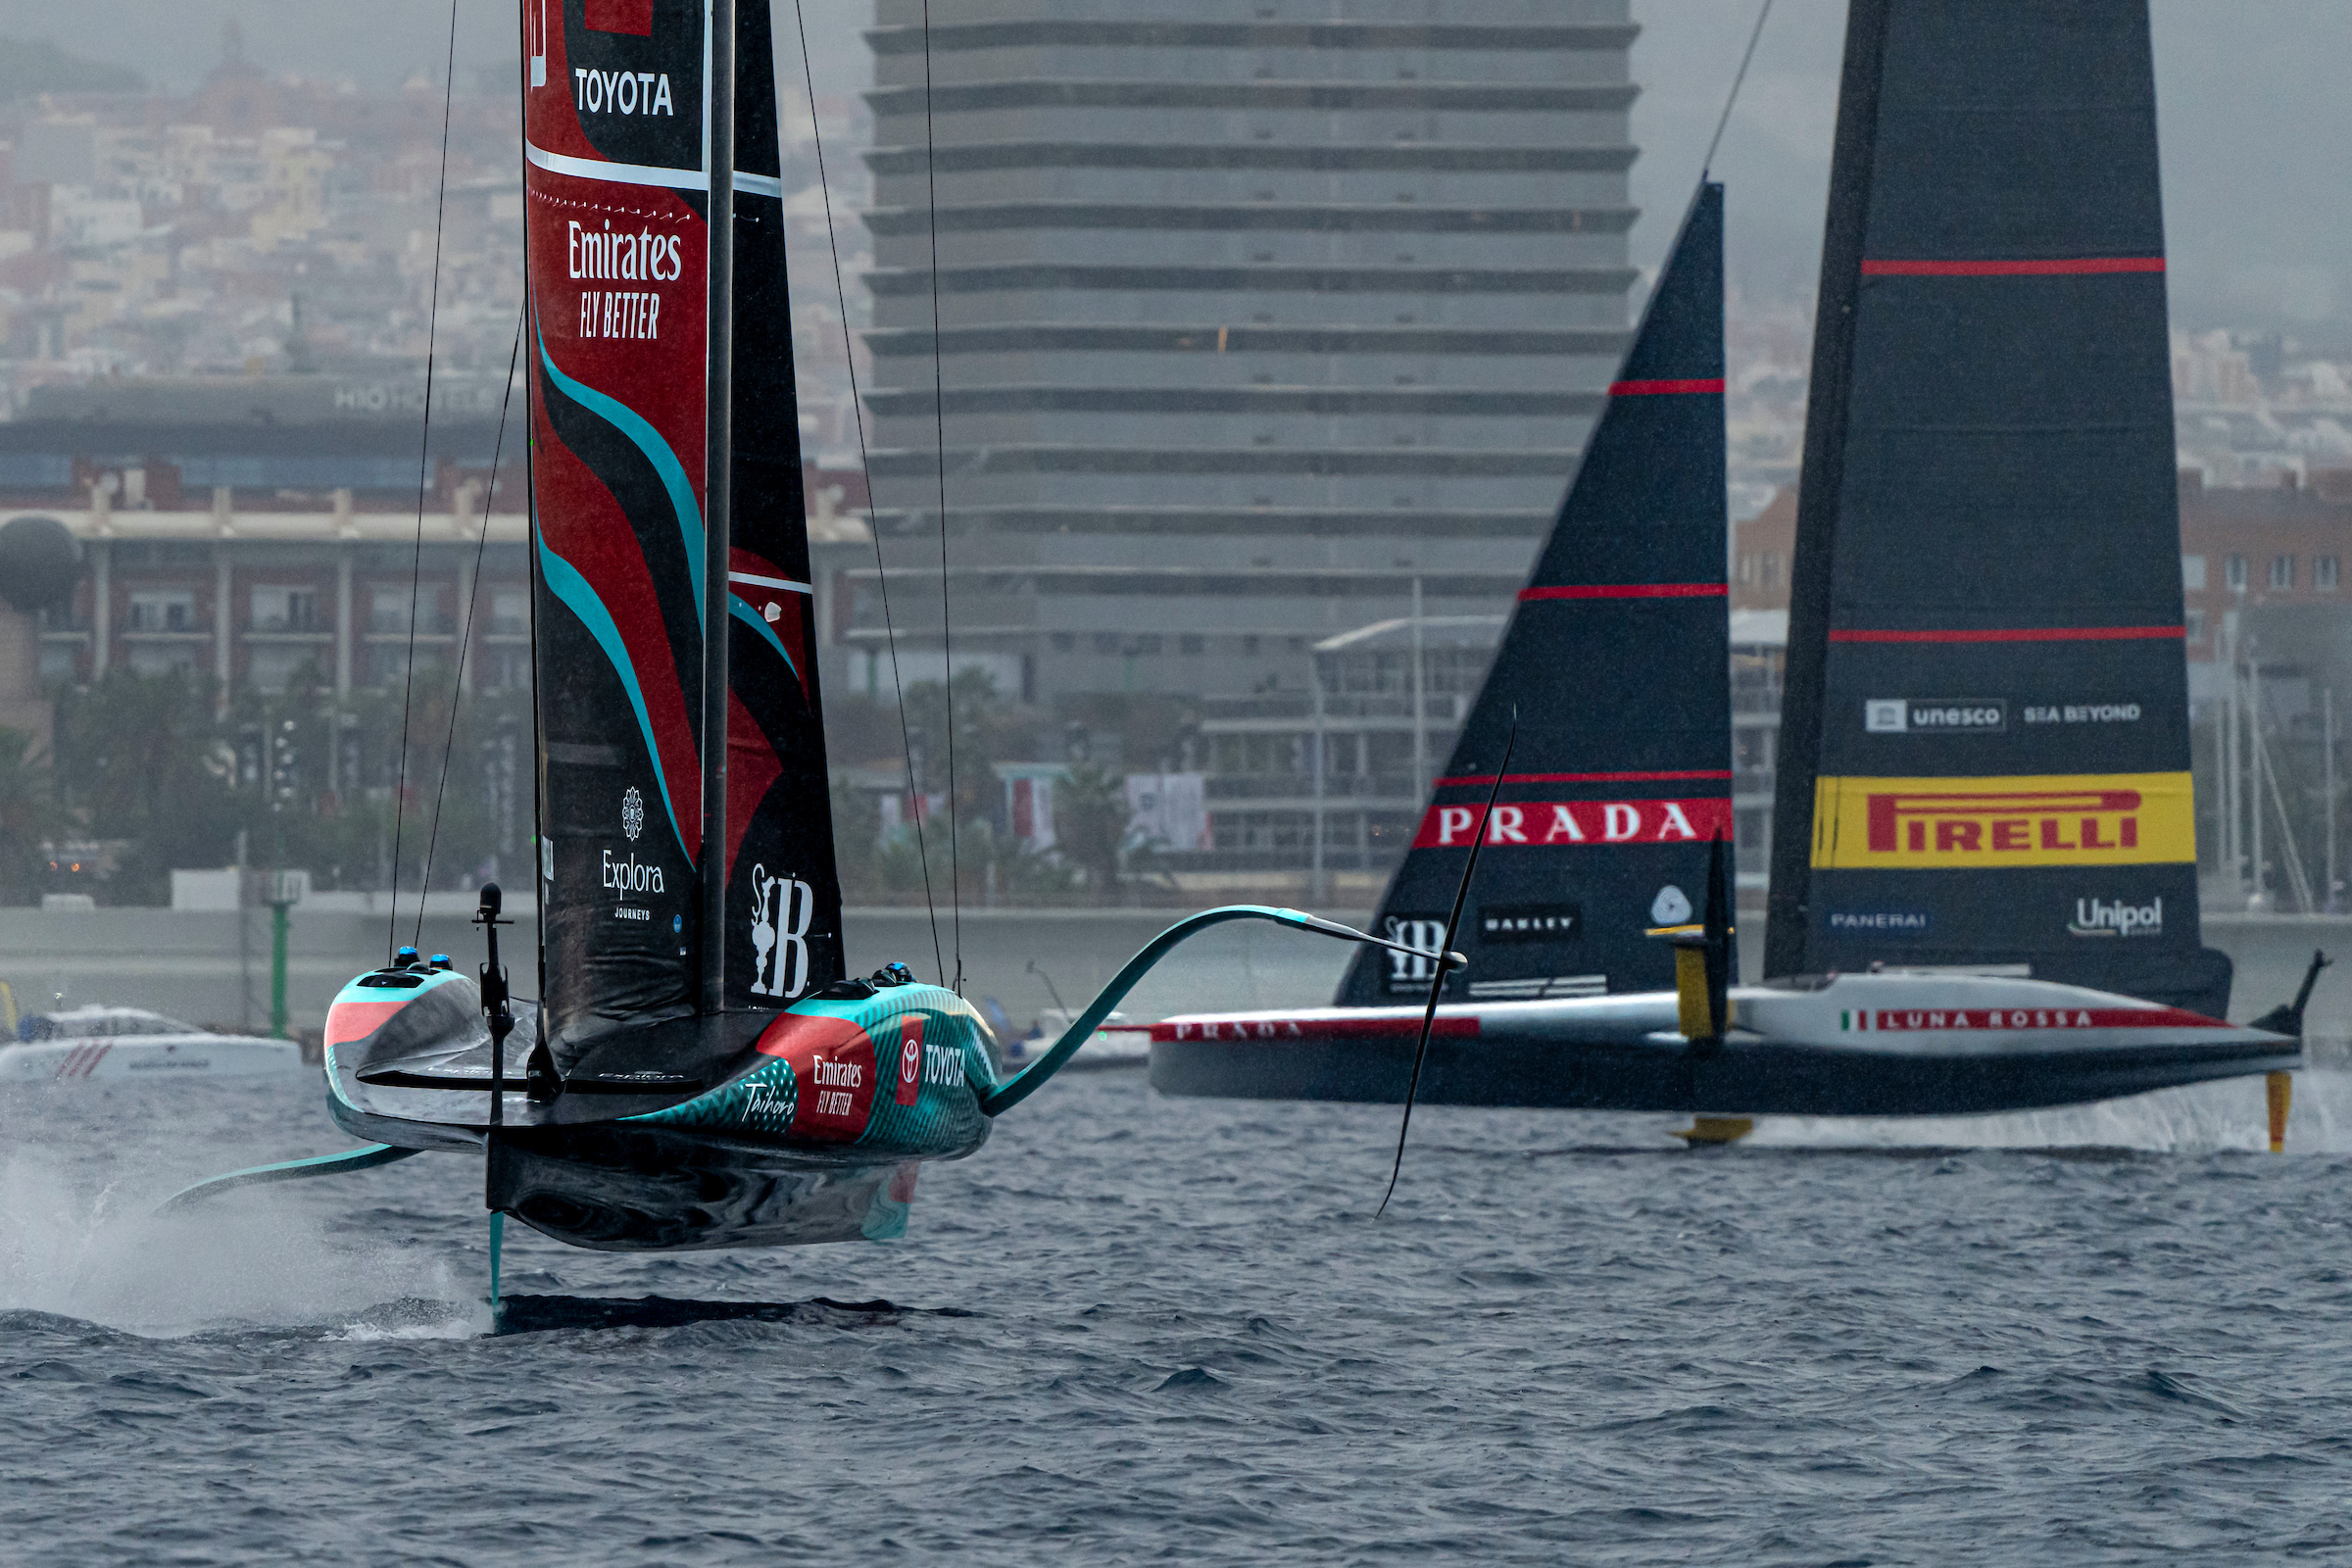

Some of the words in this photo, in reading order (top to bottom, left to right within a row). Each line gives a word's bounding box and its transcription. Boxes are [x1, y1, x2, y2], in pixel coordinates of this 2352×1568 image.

[574, 68, 674, 117] TOYOTA
[568, 219, 681, 281] Emirates
[580, 291, 600, 338] FLY
[603, 291, 660, 339] BETTER
[1913, 707, 2000, 726] unesco
[2023, 707, 2059, 723] SEA
[2064, 704, 2141, 723] BEYOND
[1439, 802, 1696, 845] PRADA
[1867, 789, 2141, 852] PIRELLI
[603, 849, 665, 901] Explora
[614, 906, 651, 921] JOURNEYS
[1831, 913, 1927, 929] PANERAI
[2077, 896, 2162, 937] Unipol
[1886, 1009, 1971, 1029] LUNA
[1988, 1008, 2093, 1028] ROSSA
[812, 1054, 863, 1088] Emirates
[925, 1044, 966, 1087] TOYOTA
[742, 1083, 795, 1122] Taihoro
[816, 1090, 831, 1113] FLY
[829, 1091, 854, 1116] BETTER
